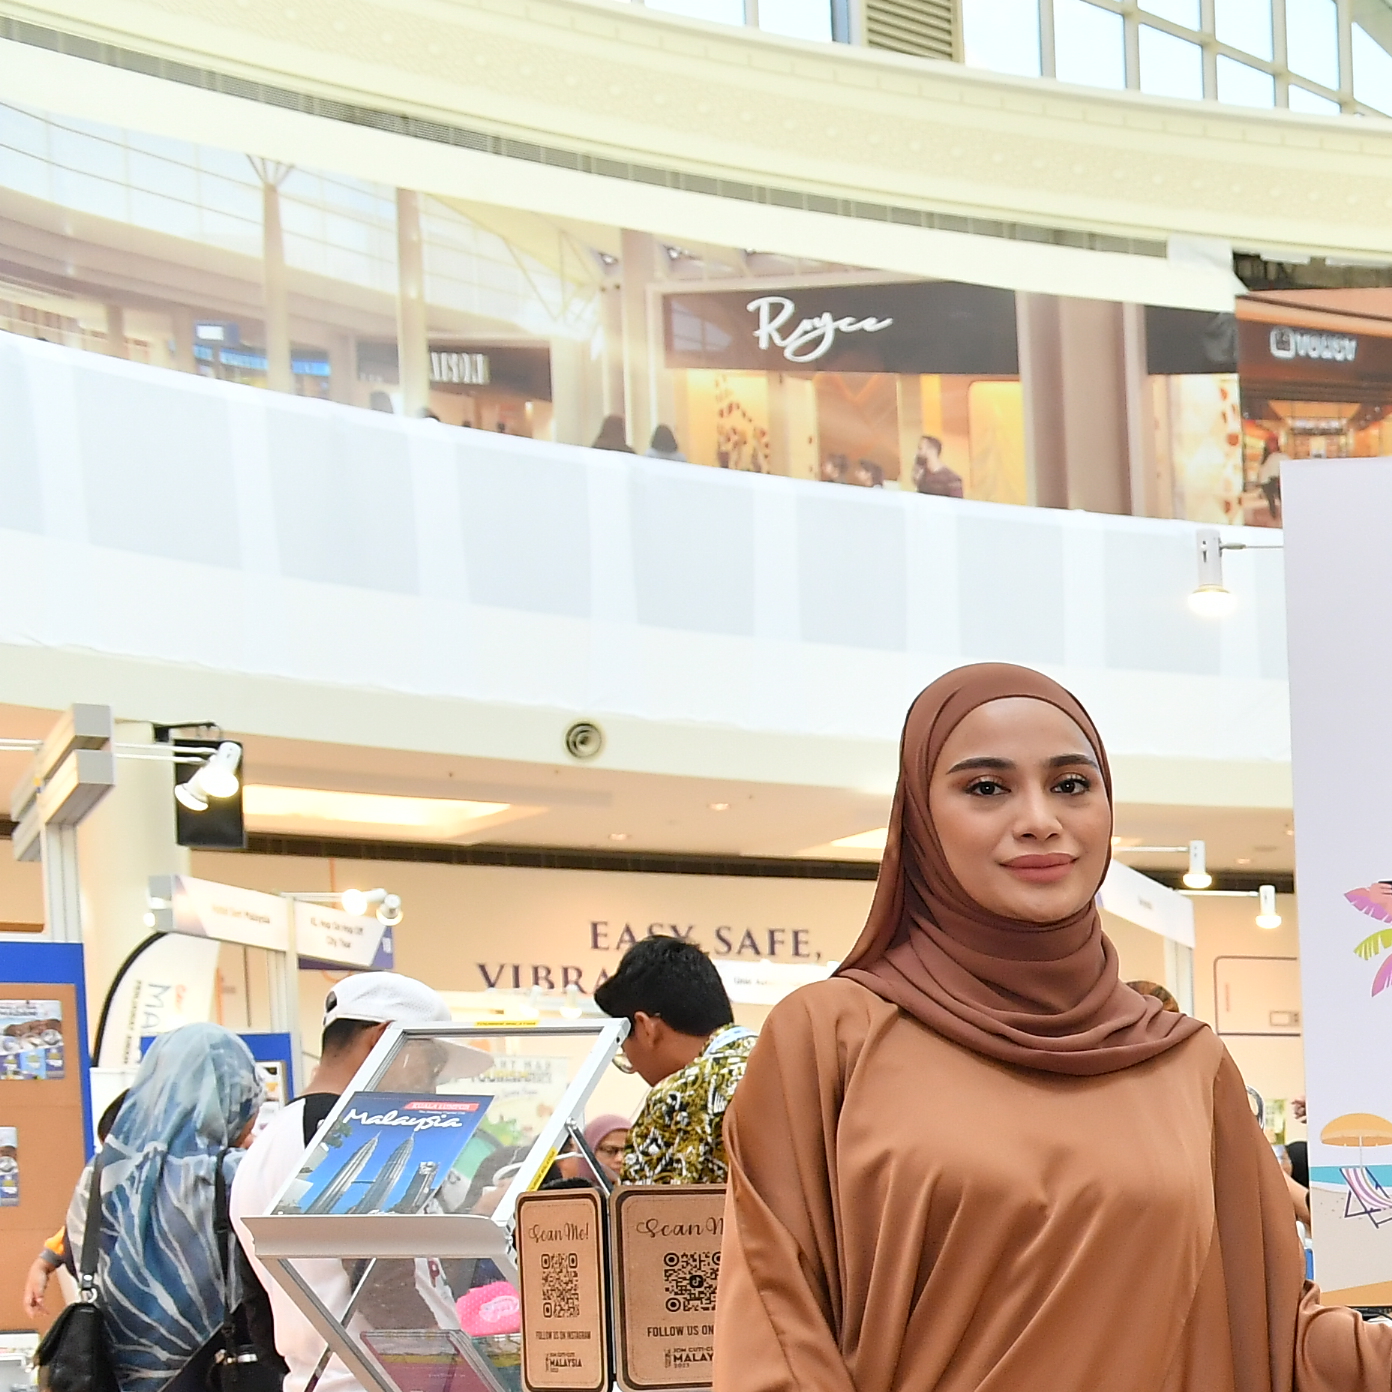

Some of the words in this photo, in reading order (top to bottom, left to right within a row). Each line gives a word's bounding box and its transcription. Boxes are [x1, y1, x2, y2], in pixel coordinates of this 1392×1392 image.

[342, 1108, 463, 1132] Malaysia
[635, 1217, 705, 1239] Scan
[535, 1330, 553, 1340] FOLLOW
[646, 1326, 685, 1338] FOLLOW
[686, 1325, 700, 1336] US
[549, 1357, 582, 1367] MALAYSIA
[673, 1352, 714, 1363] MALAY
